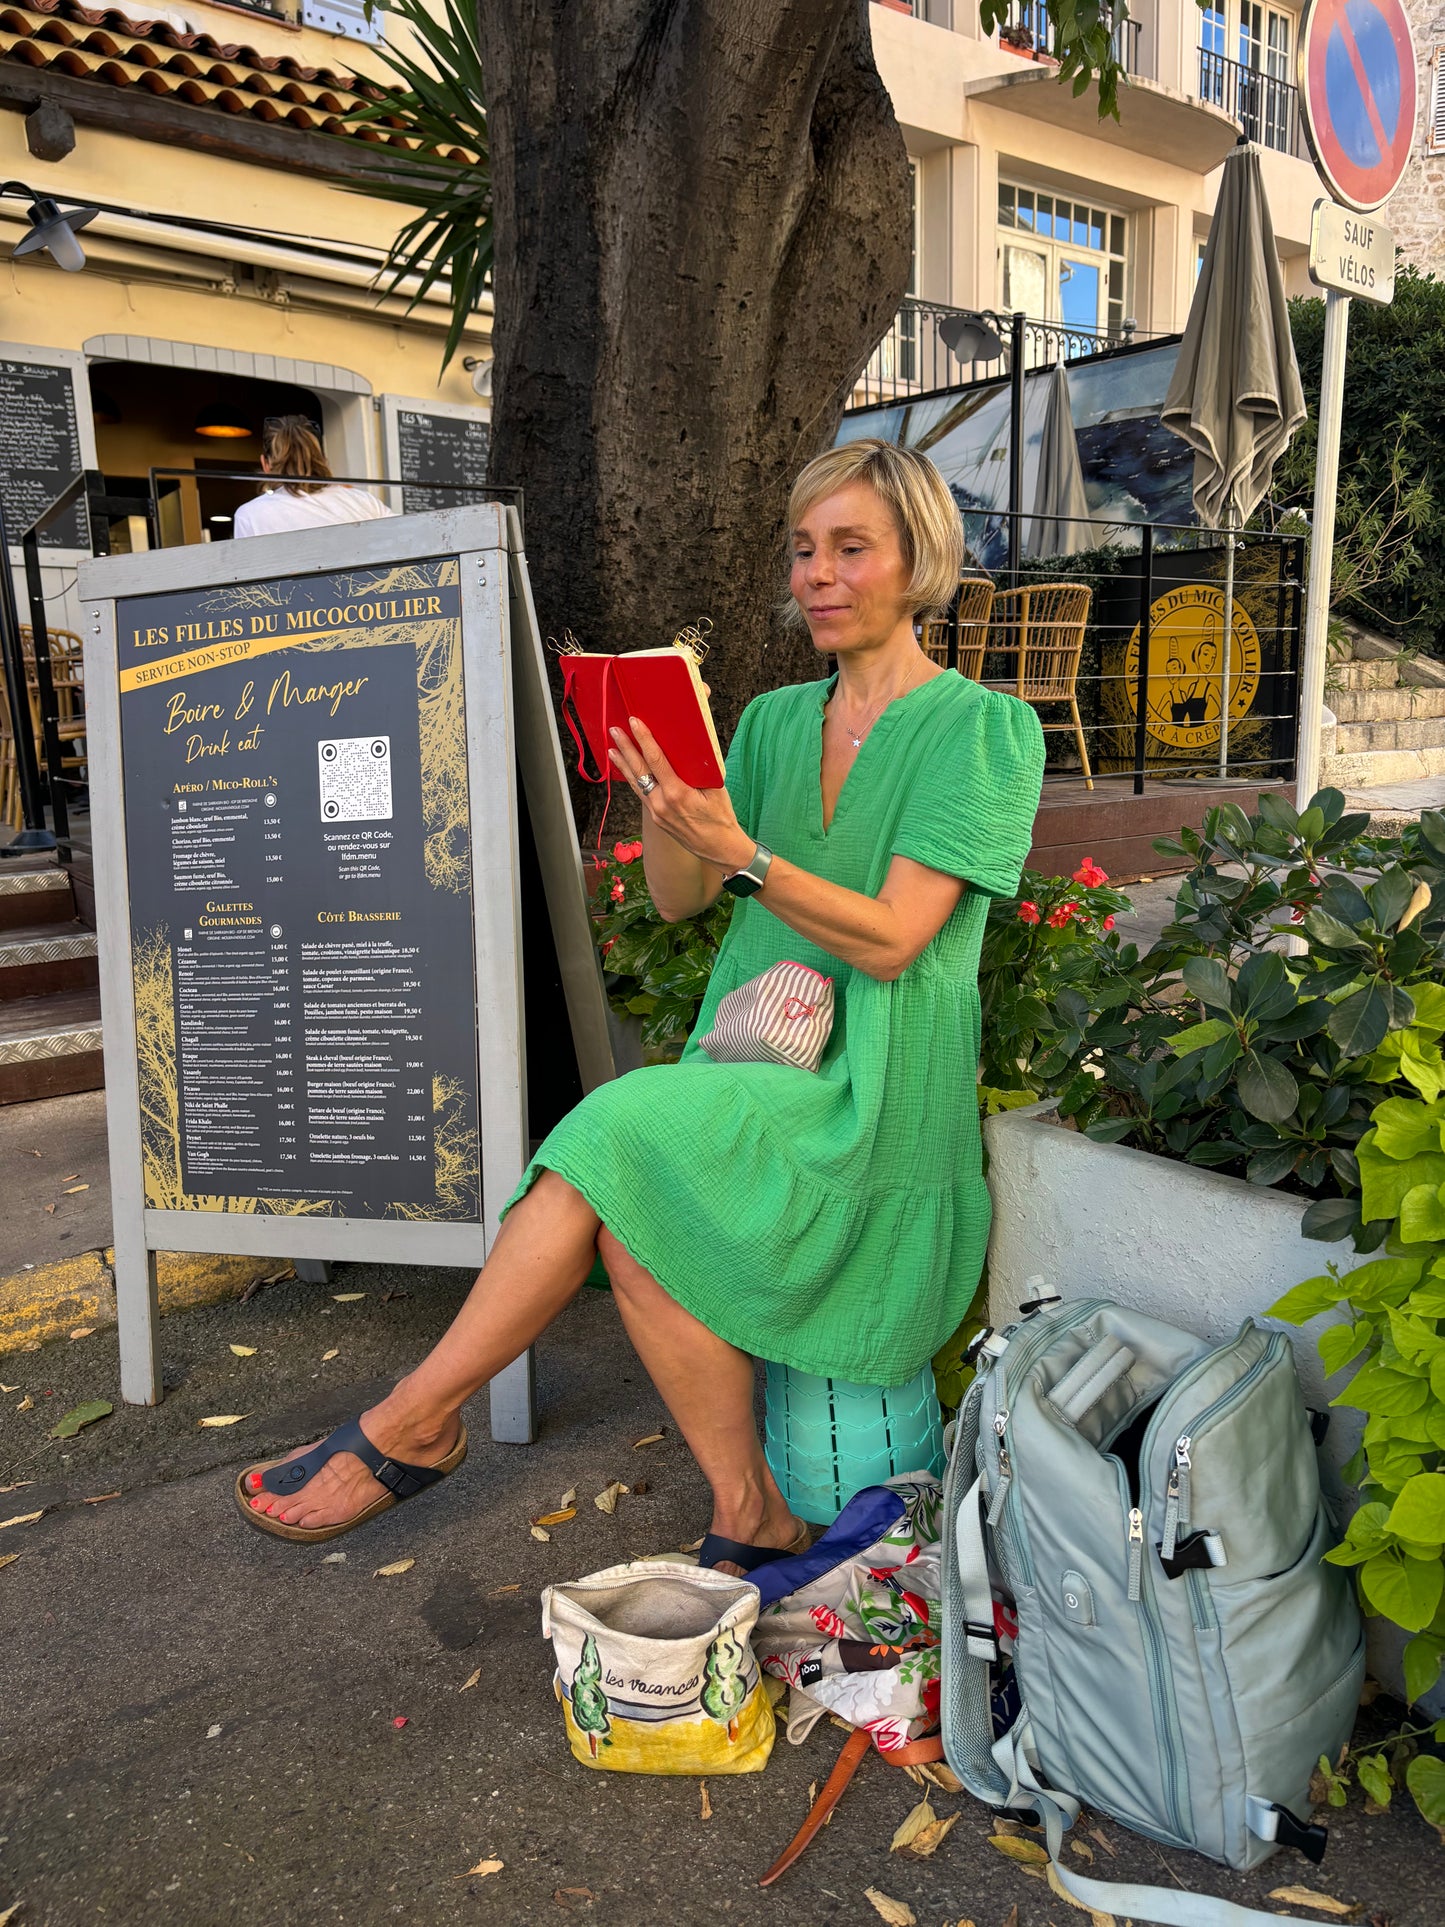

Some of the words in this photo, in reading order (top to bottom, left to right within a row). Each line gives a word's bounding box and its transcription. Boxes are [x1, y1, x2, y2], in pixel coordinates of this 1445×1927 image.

[1344, 220, 1374, 250] SAUF
[1339, 255, 1375, 288] VÉLOS
[133, 627, 169, 649] LES
[175, 617, 243, 642] FILLES
[251, 614, 279, 633] DU
[286, 595, 442, 630] MICOCOULIER
[1168, 592, 1189, 609] DU
[1193, 589, 1256, 695] MICCOULIER
[136, 660, 185, 684] SERVICE
[187, 641, 251, 670] NON-STOP
[162, 692, 225, 736] Boire
[233, 681, 255, 722] &
[266, 670, 369, 718] Manger
[1171, 728, 1179, 743] À
[1186, 711, 1237, 744] CRÊPS
[185, 730, 231, 765] Drink
[237, 724, 265, 754] eat
[323, 833, 351, 841] Scannez
[361, 832, 372, 840] QR
[374, 830, 393, 839] Code,
[338, 842, 378, 850] rendez-vous
[341, 853, 377, 861] lfdm.menu
[606, 1669, 624, 1688] les
[628, 1674, 699, 1695] vacances
